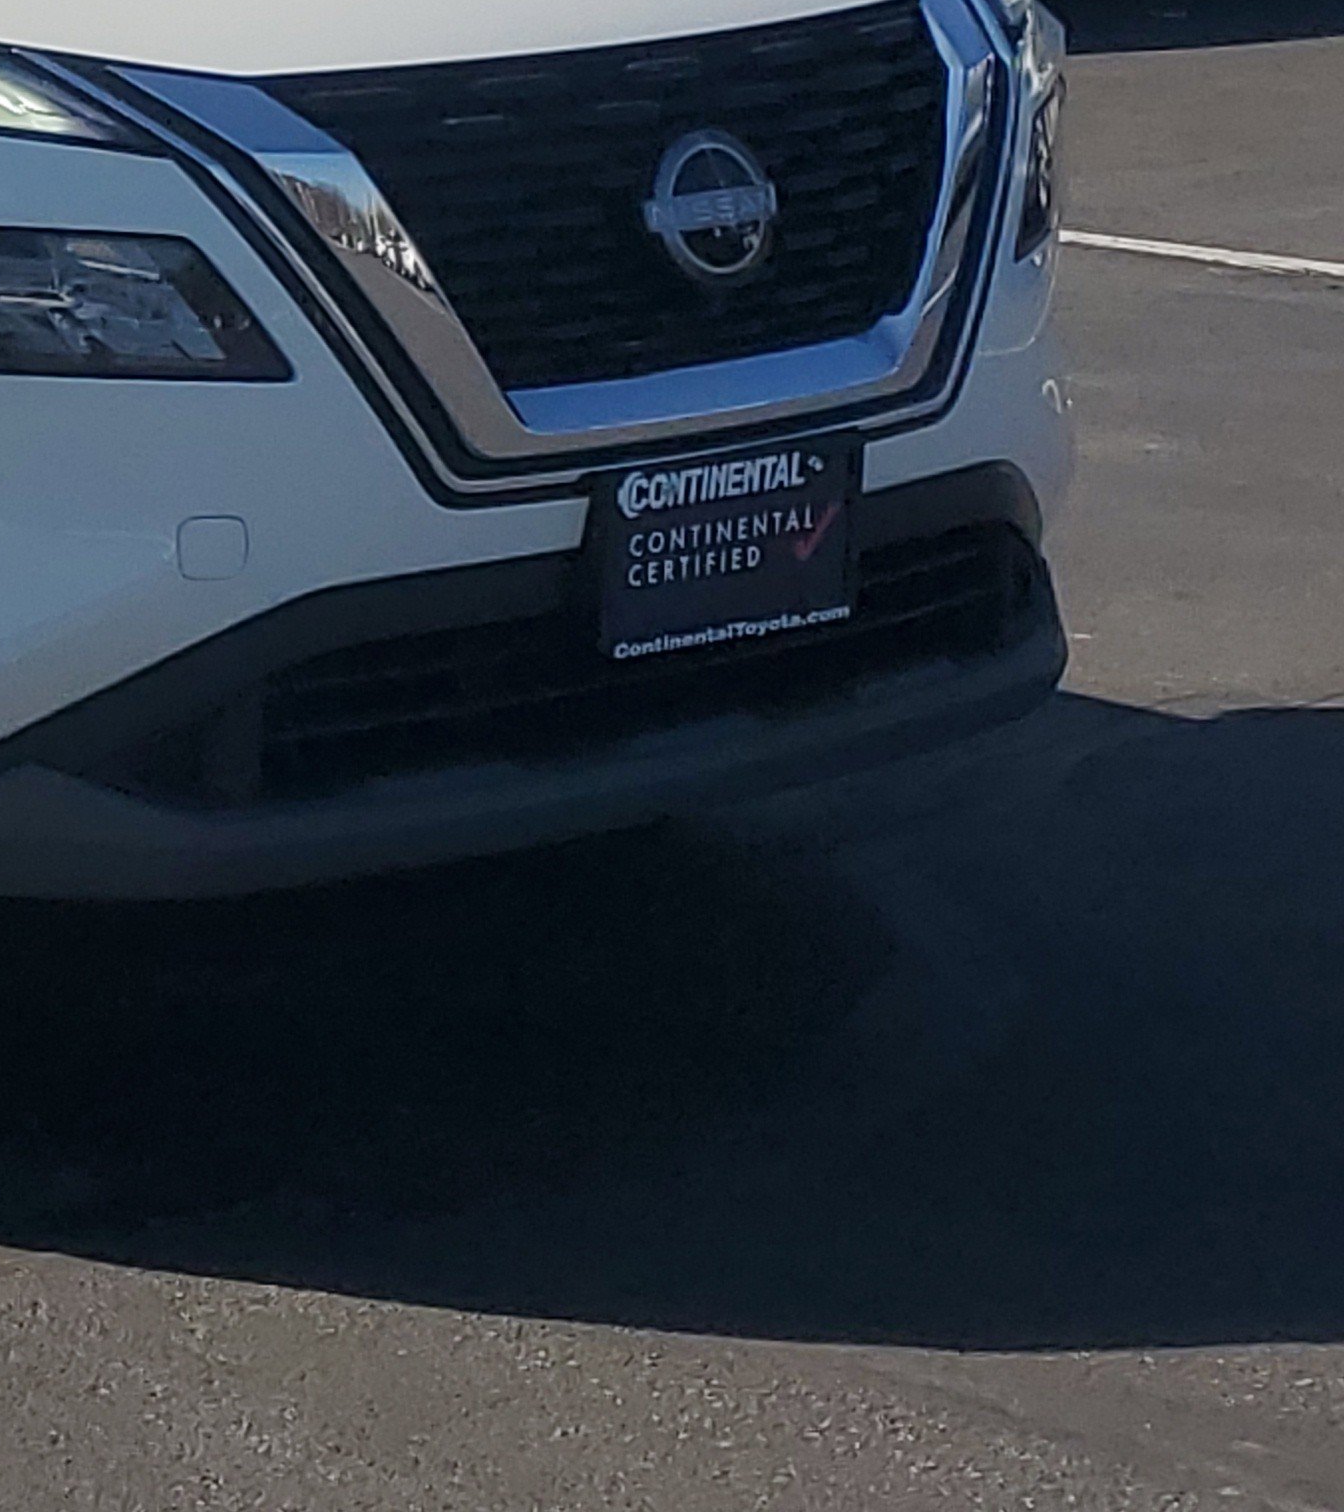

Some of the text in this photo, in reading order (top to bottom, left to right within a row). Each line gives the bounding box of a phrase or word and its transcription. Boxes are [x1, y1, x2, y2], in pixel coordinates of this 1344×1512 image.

[617, 451, 806, 518] CONTINENTAL
[628, 503, 814, 557] CONTINENTAL
[628, 546, 762, 587] CERTIFIED
[614, 605, 851, 659] ContinentalToyota.com
